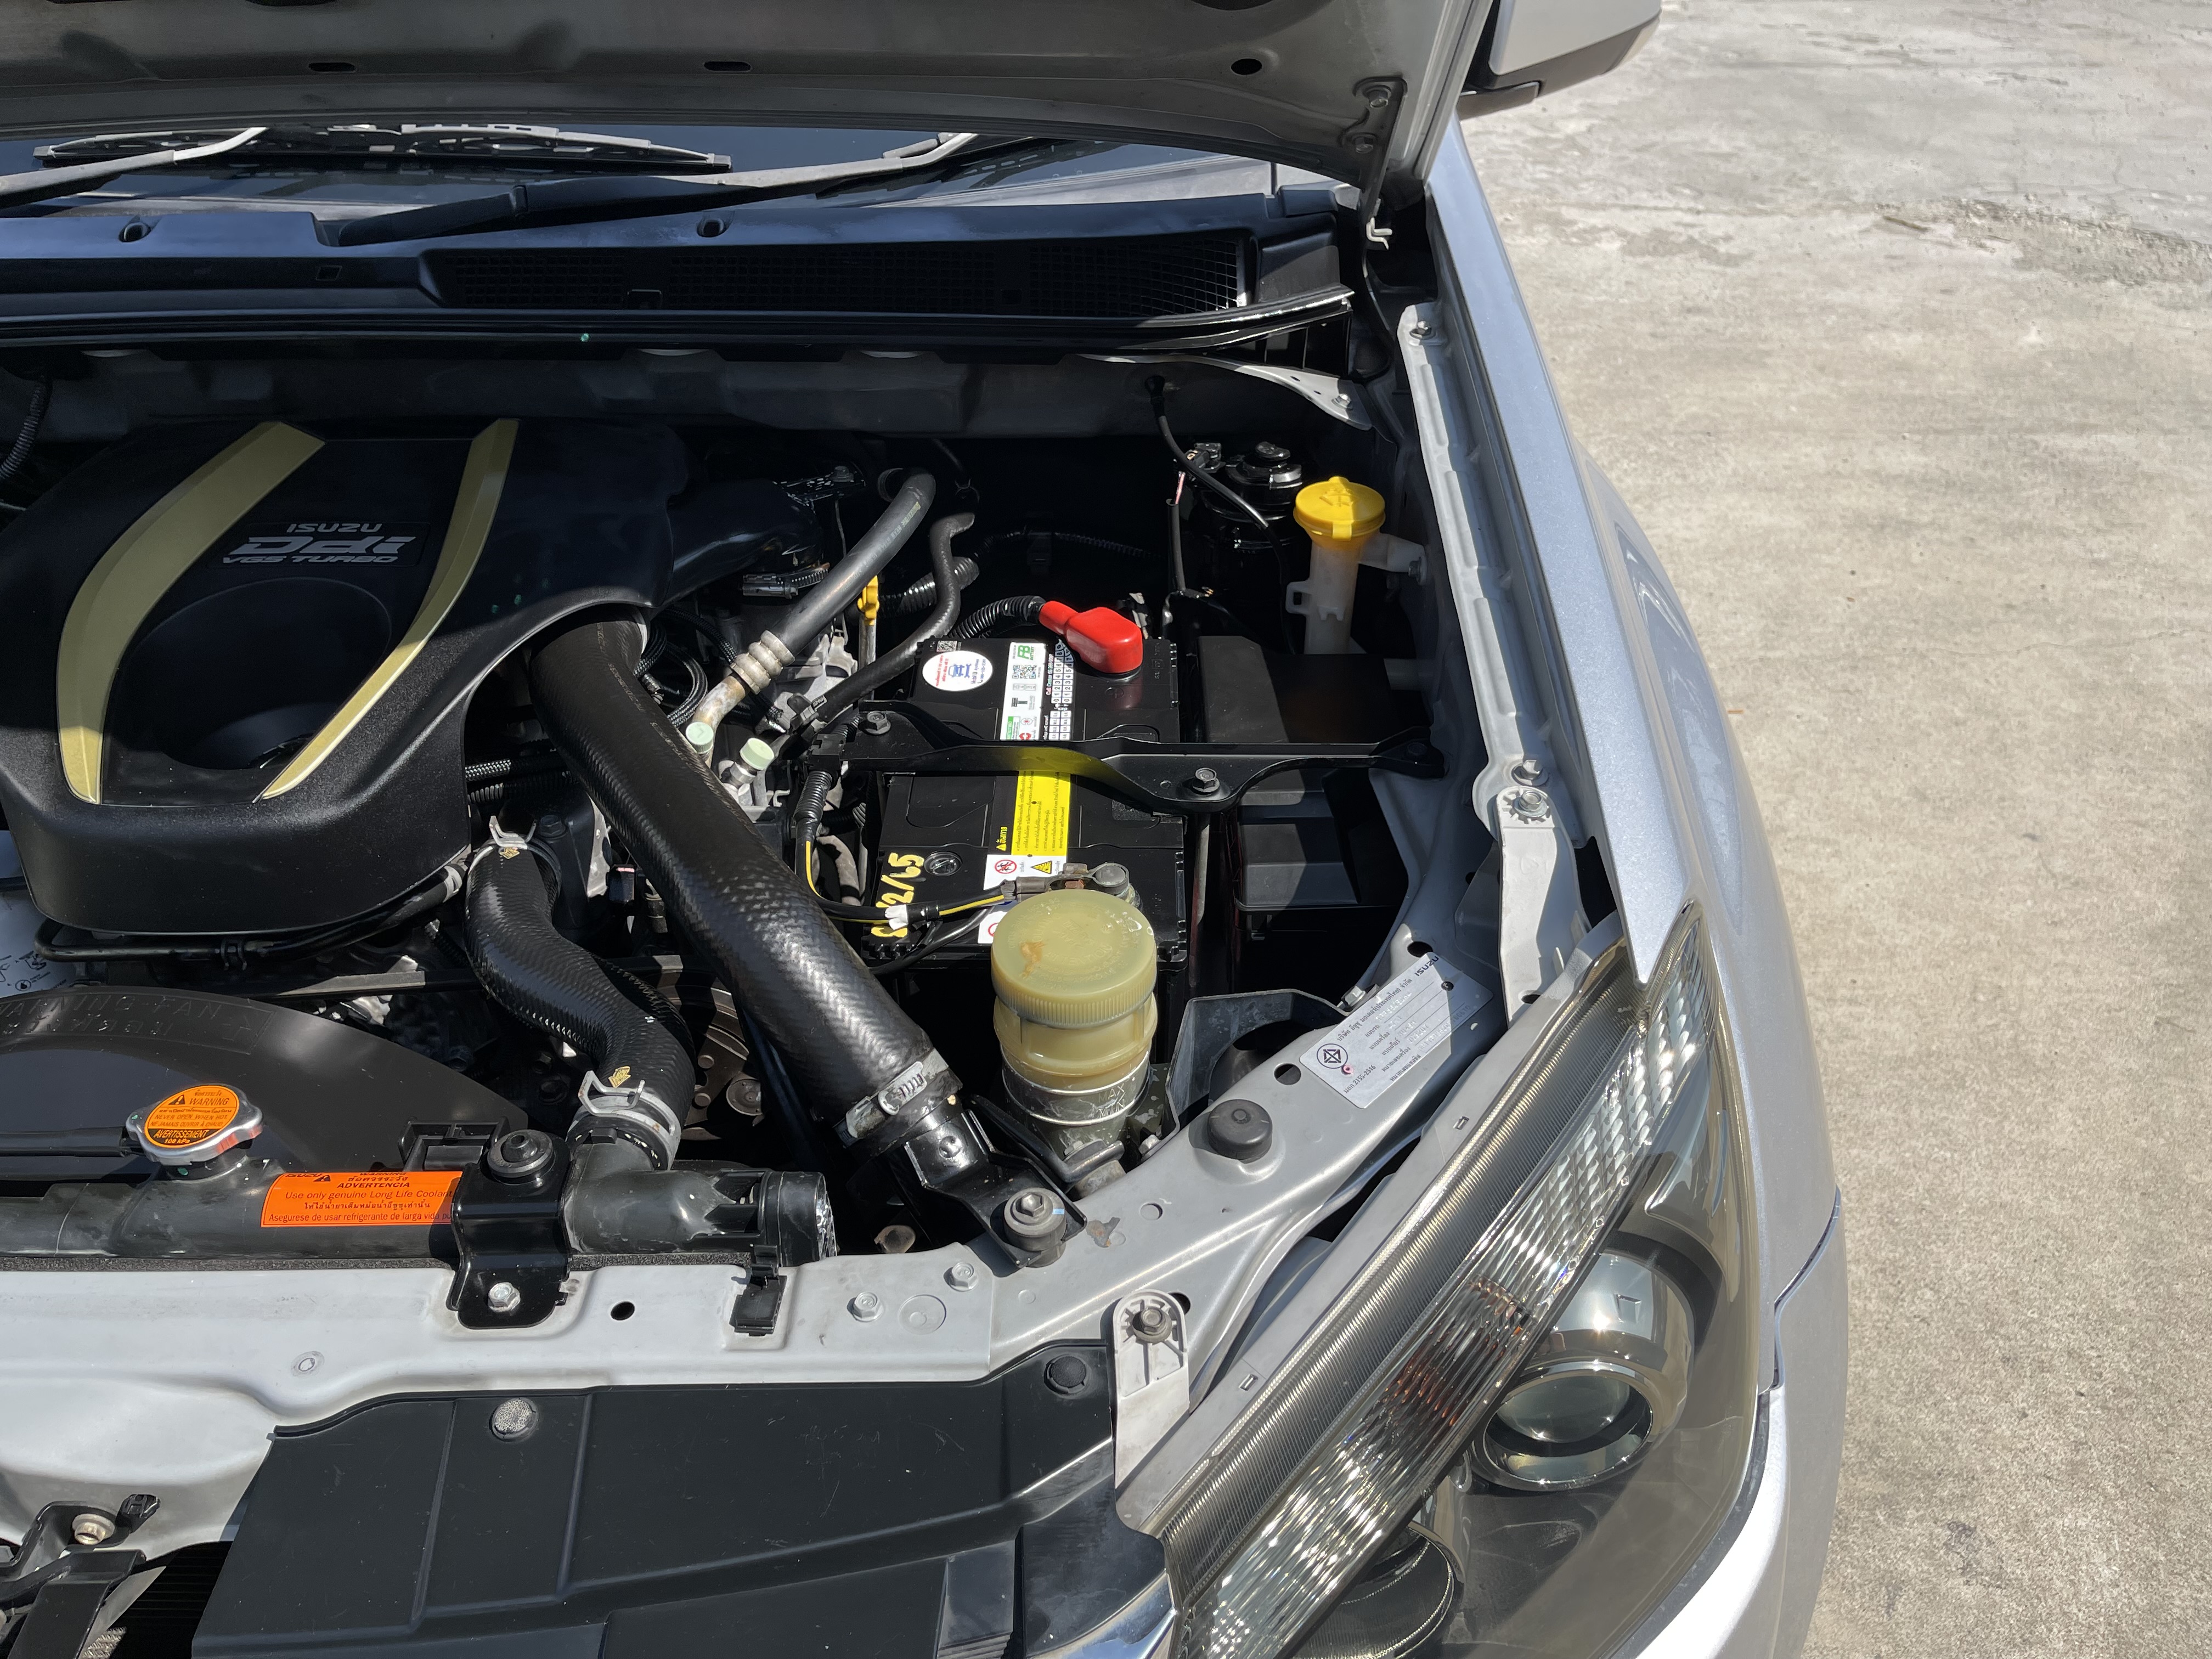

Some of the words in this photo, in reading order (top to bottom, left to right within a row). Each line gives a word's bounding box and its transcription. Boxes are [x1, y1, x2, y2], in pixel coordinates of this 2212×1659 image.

[286, 523, 382, 533] ISUZU
[291, 555, 398, 563] TURBO
[1414, 956, 1439, 977] ISUZU
[1097, 1082, 1126, 1102] MAX
[1097, 1101, 1125, 1119] MIN
[153, 1129, 210, 1138] AVERTISSEMENT
[307, 1191, 327, 1200] only
[328, 1192, 367, 1200] genuine
[370, 1190, 394, 1199] Long
[269, 1214, 309, 1223] Asegurese
[312, 1213, 321, 1221] de
[343, 1212, 387, 1222] refrigerante
[390, 1212, 400, 1220] de
[402, 1212, 422, 1221] larga
